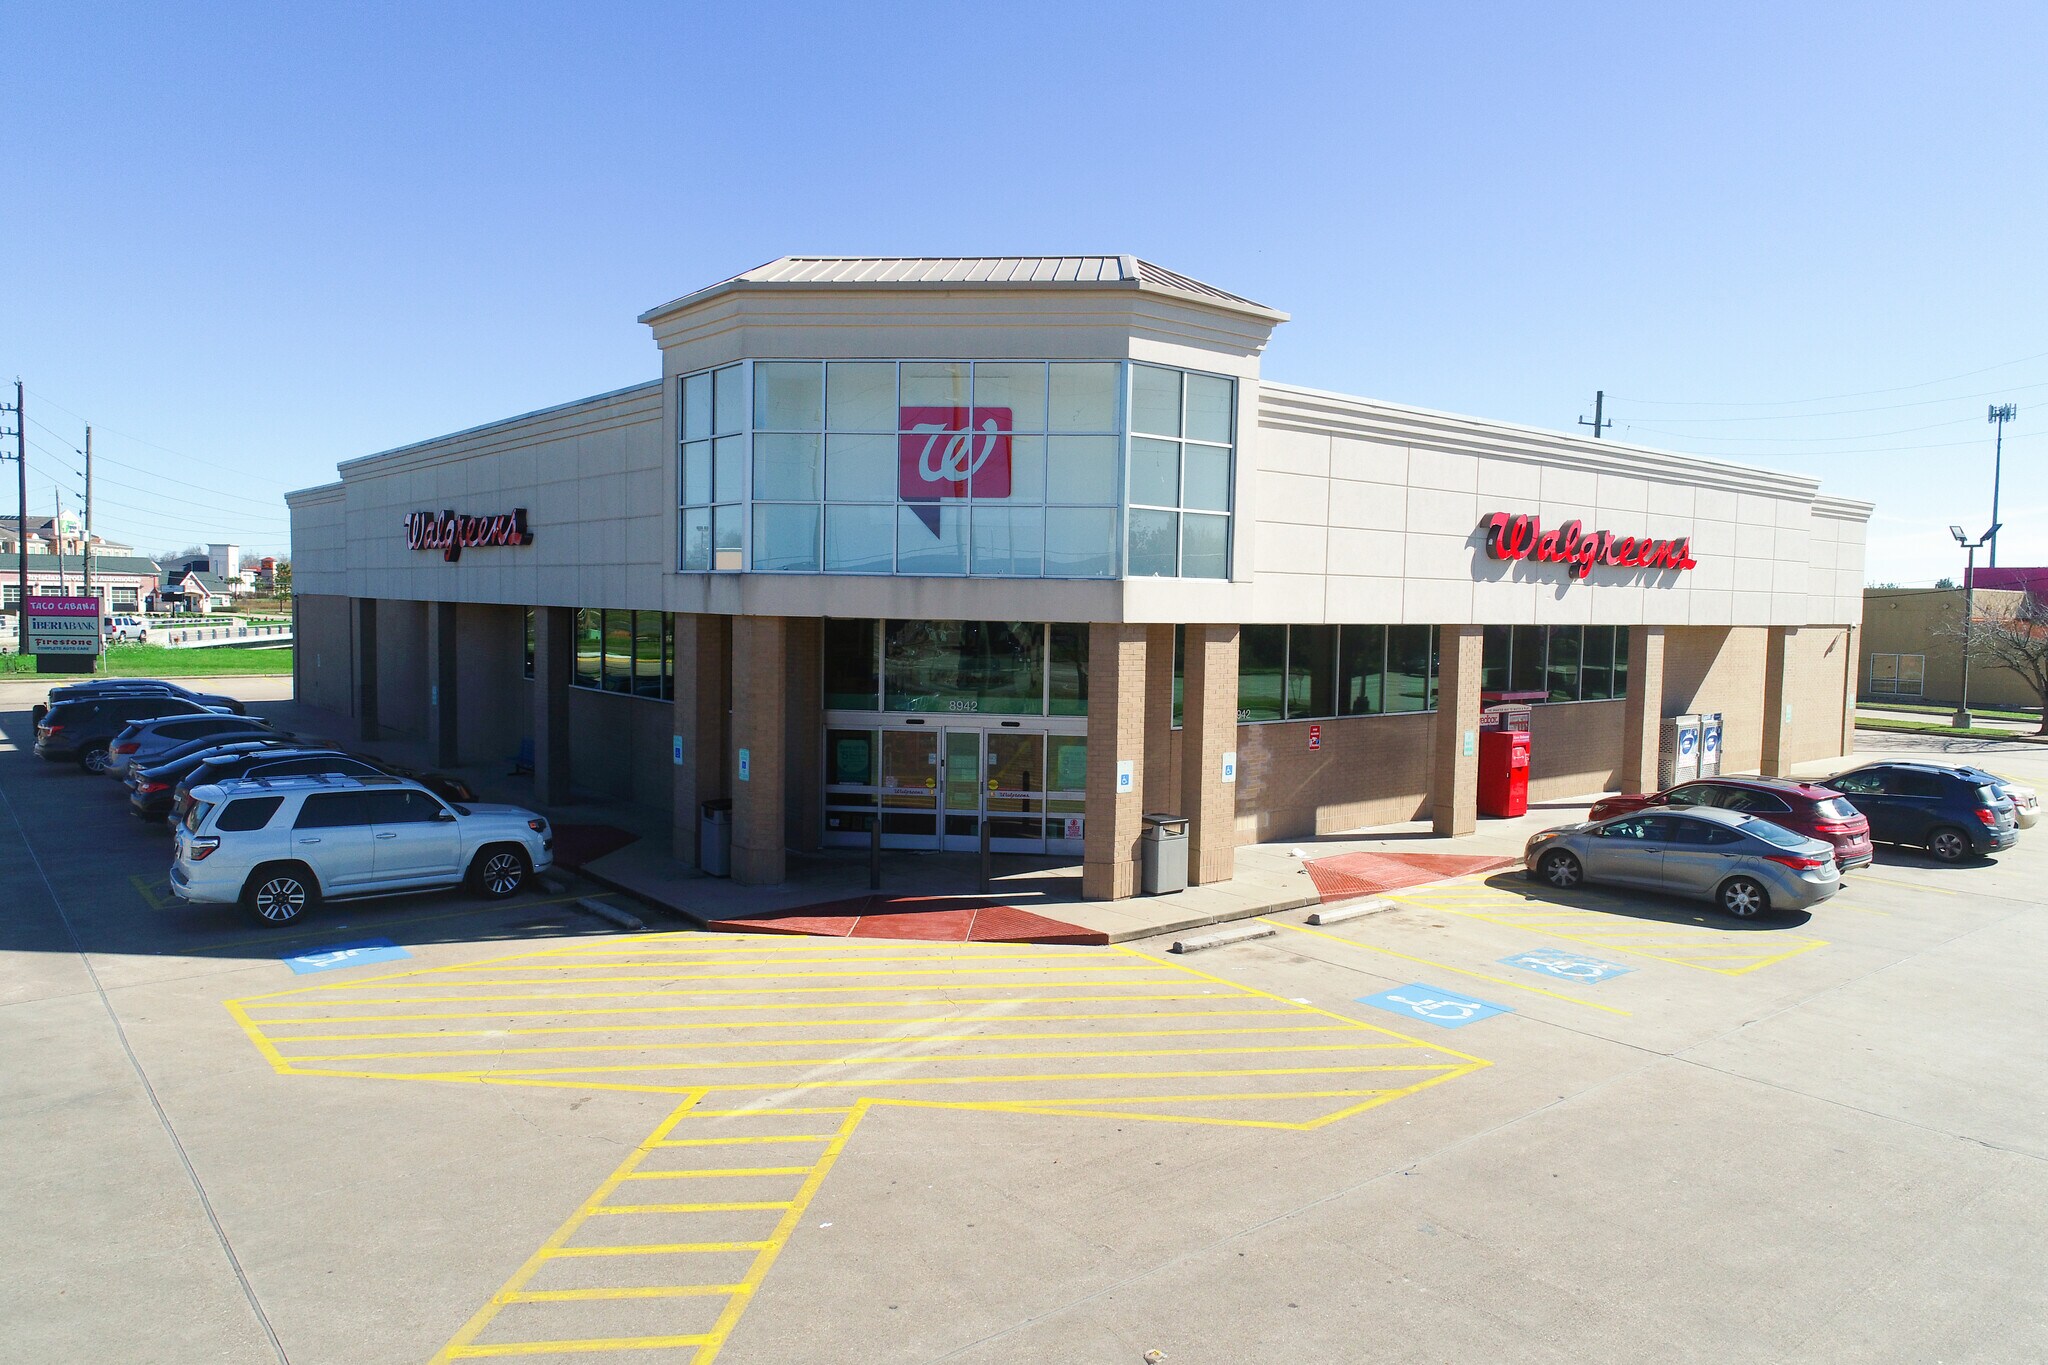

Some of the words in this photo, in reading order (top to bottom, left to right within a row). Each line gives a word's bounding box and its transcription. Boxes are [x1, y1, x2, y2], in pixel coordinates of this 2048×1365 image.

[404, 509, 526, 562] Walgreens
[1485, 512, 1697, 579] Walgreens
[30, 602, 54, 610] TACO
[58, 602, 96, 611] CABANA
[34, 638, 93, 646] Firestone
[949, 700, 978, 712] 8942
[1237, 709, 1251, 719] 942
